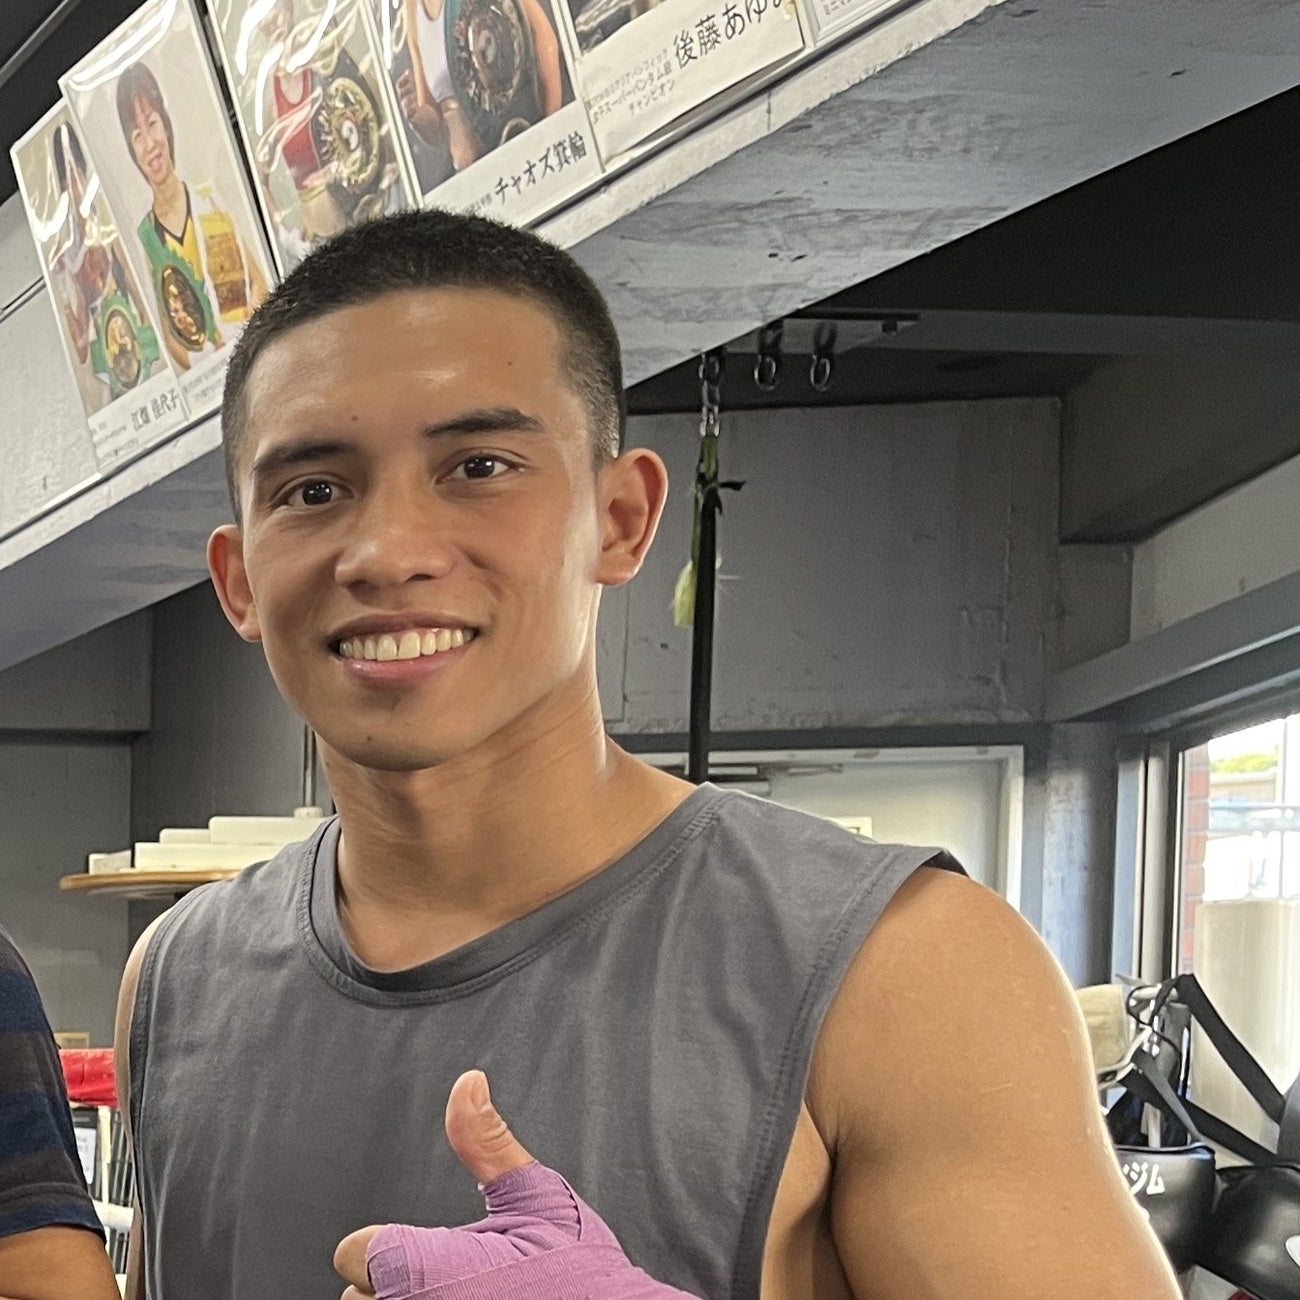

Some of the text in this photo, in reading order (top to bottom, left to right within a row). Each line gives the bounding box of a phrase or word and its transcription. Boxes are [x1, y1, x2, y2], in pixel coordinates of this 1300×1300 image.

[673, 0, 781, 69] 後藤あゆ
[1122, 1161, 1166, 1195] ジム
